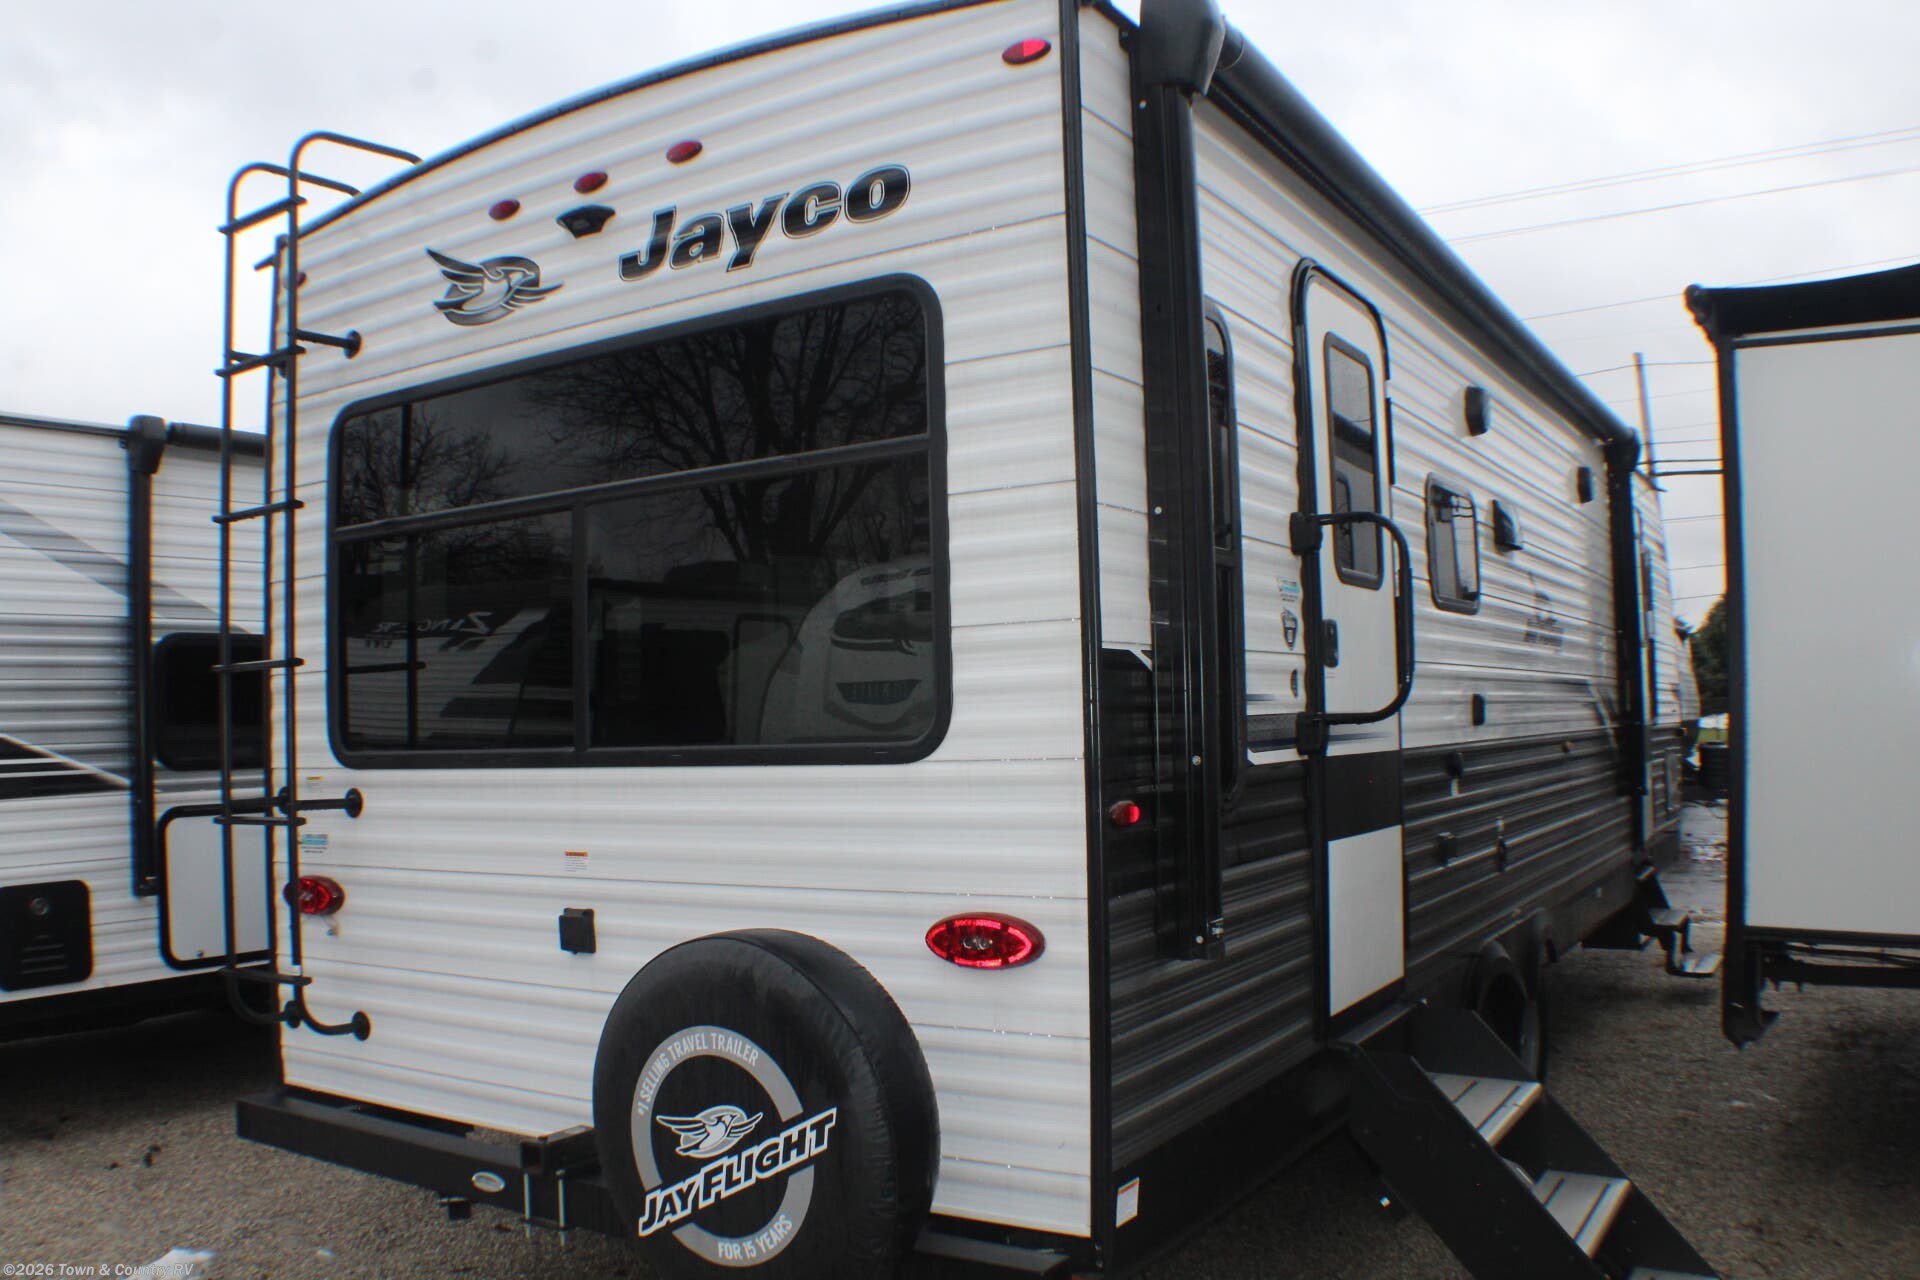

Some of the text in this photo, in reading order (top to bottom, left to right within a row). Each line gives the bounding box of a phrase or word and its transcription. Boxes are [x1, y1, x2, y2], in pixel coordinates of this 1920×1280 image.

[619, 164, 911, 281] Jayco
[640, 1053, 671, 1101] SELLING
[667, 1033, 708, 1062] TRAVEL
[710, 1033, 759, 1066] TRAILER
[718, 1214, 793, 1260] FOR 15 YEARS
